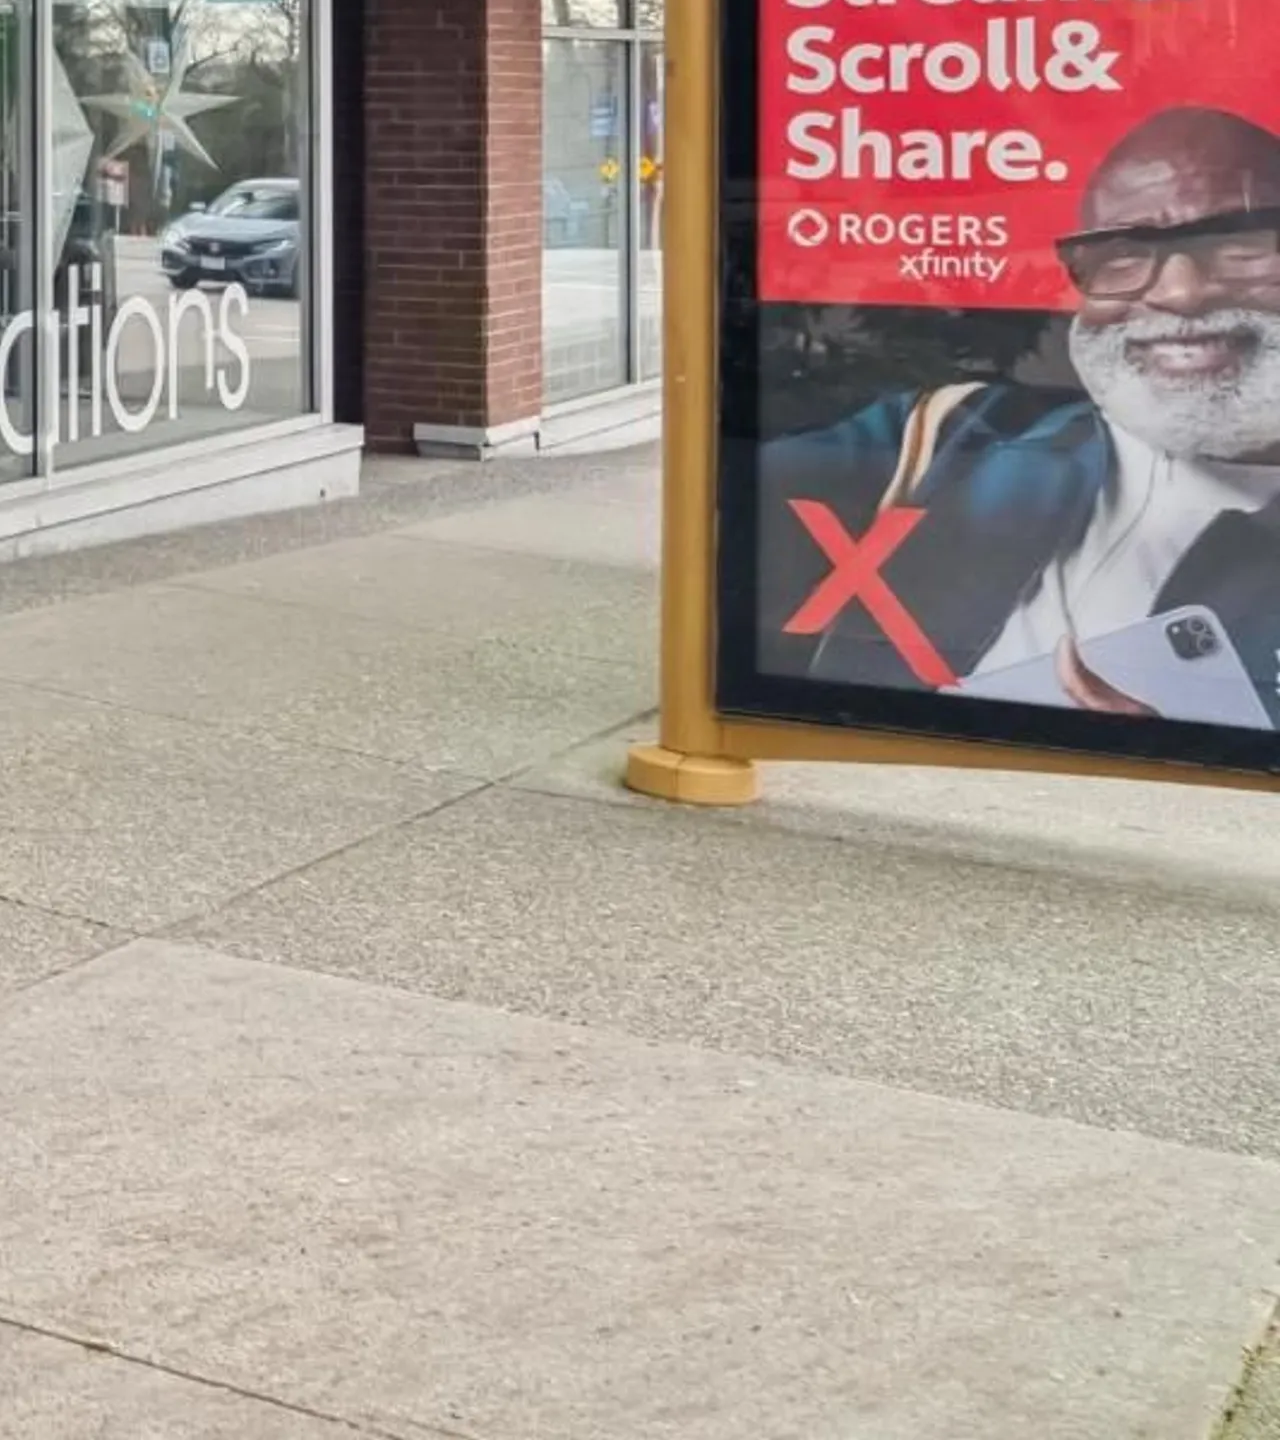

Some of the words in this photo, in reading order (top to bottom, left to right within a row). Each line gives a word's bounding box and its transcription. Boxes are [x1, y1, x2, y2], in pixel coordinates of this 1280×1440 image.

[784, 16, 1124, 95] Scroll&
[784, 106, 1070, 182] Share.
[839, 212, 1009, 248] ROGERS
[899, 247, 1009, 284] xfinity
